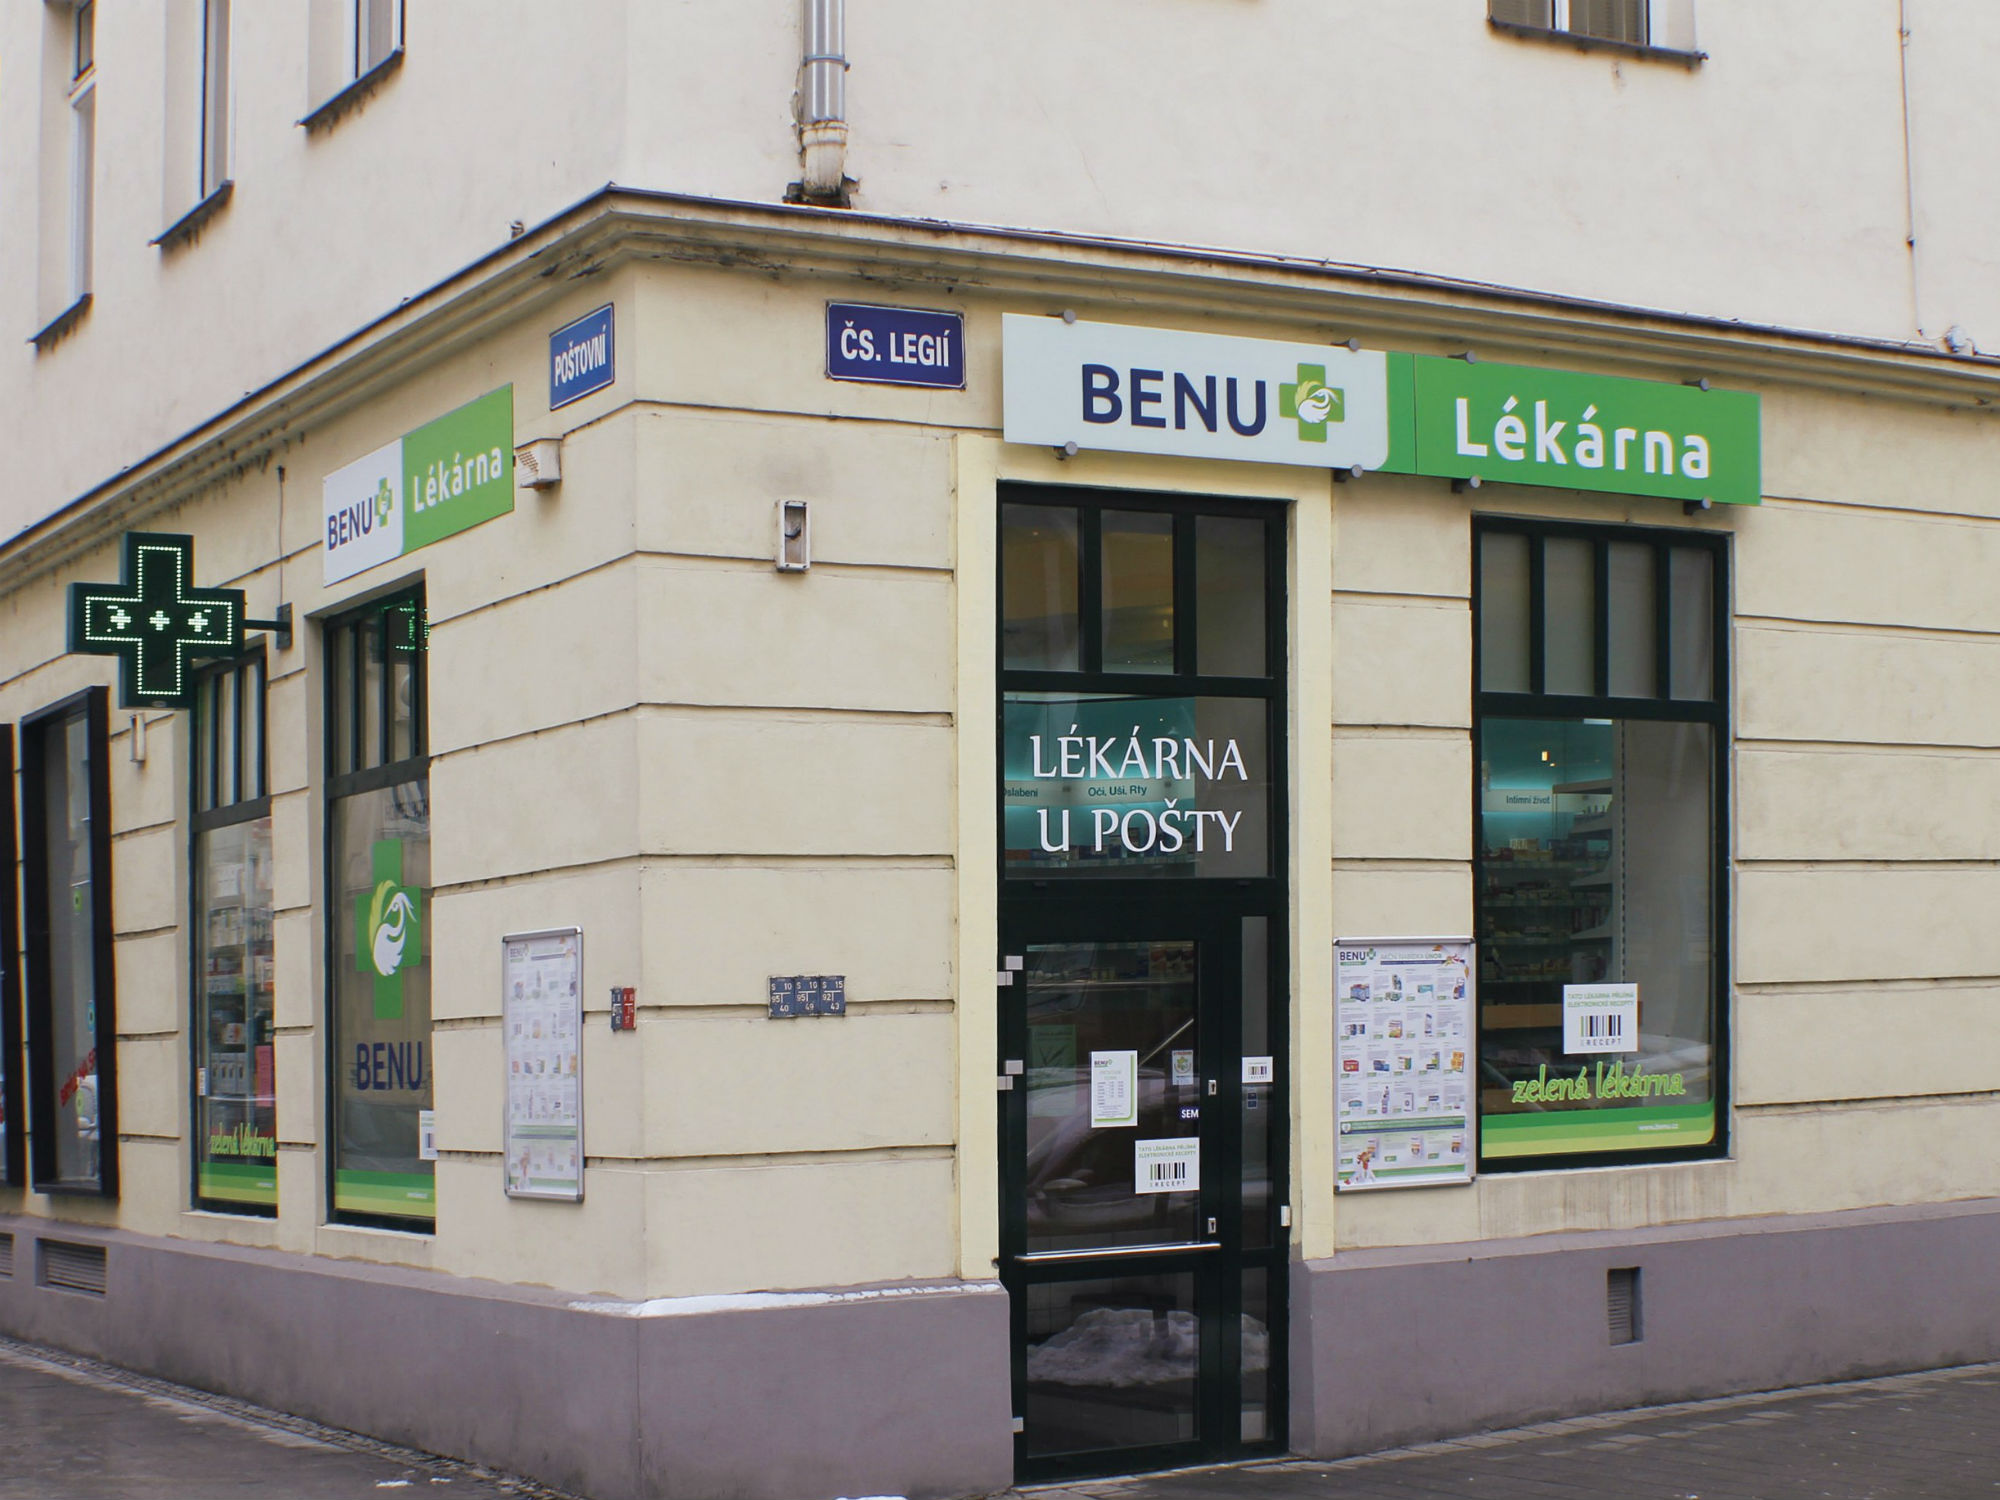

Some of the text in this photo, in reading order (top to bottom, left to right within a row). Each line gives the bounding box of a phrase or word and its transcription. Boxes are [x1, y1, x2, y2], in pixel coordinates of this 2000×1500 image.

[554, 325, 607, 387] POŠTOVNÍ
[840, 321, 950, 368] ČS. LEGIÍ
[1081, 363, 1268, 437] BENU
[1455, 395, 1711, 479] Lékárna
[413, 446, 503, 513] Lékárna
[328, 497, 373, 551] BENU
[1029, 724, 1249, 781] LÉKÁRNA
[1130, 784, 1148, 797] Rty
[1036, 798, 1243, 852] U POŠTY
[1339, 951, 1366, 961] BENU
[771, 982, 793, 991] S 10
[796, 981, 818, 990] S 10
[822, 980, 844, 989] S 15
[356, 1041, 423, 1091] BENU
[1511, 1060, 1687, 1104] zelená lékárna
[1181, 1108, 1199, 1119] SEM
